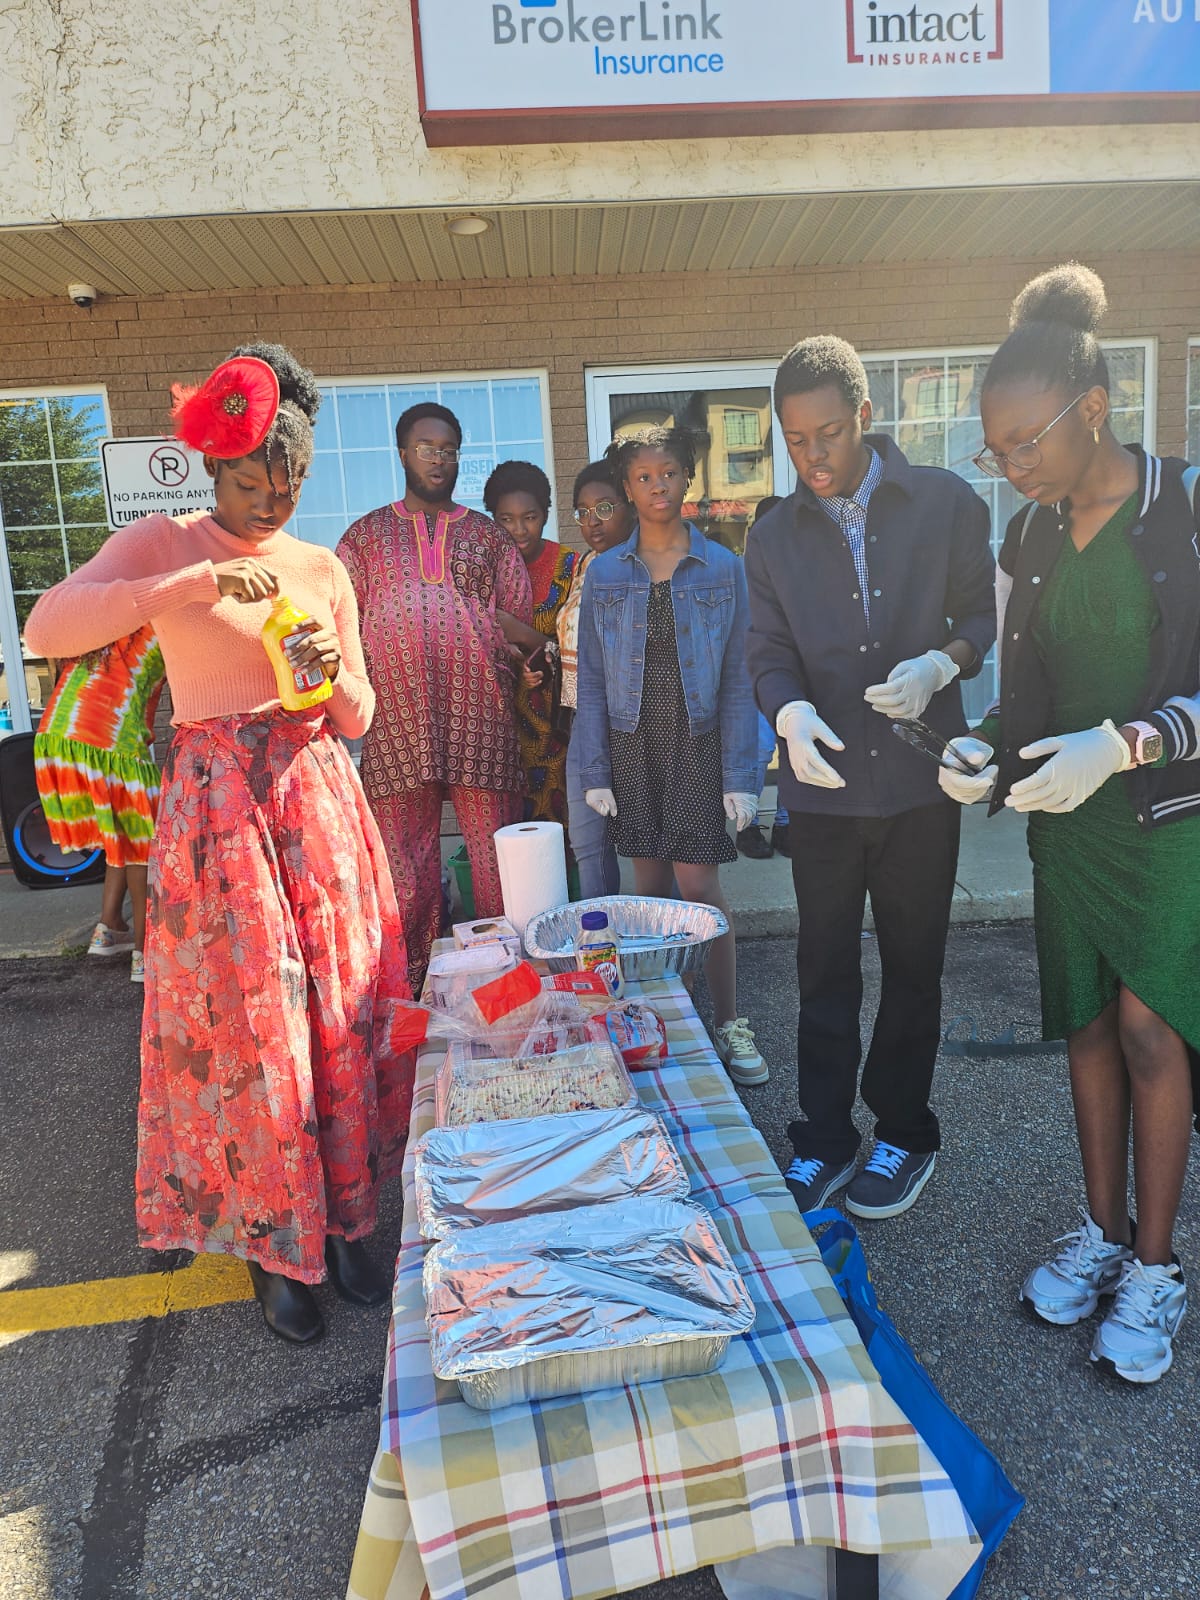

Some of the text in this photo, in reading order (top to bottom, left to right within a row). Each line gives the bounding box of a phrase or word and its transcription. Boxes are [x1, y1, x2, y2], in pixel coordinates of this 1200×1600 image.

[492, 0, 723, 44] BrokerLink
[866, 1, 986, 43] intact
[594, 46, 724, 75] Insurance
[869, 51, 982, 66] INSURANCE
[459, 459, 494, 475] OSED
[113, 492, 130, 502] NO
[133, 490, 183, 501] PARKING
